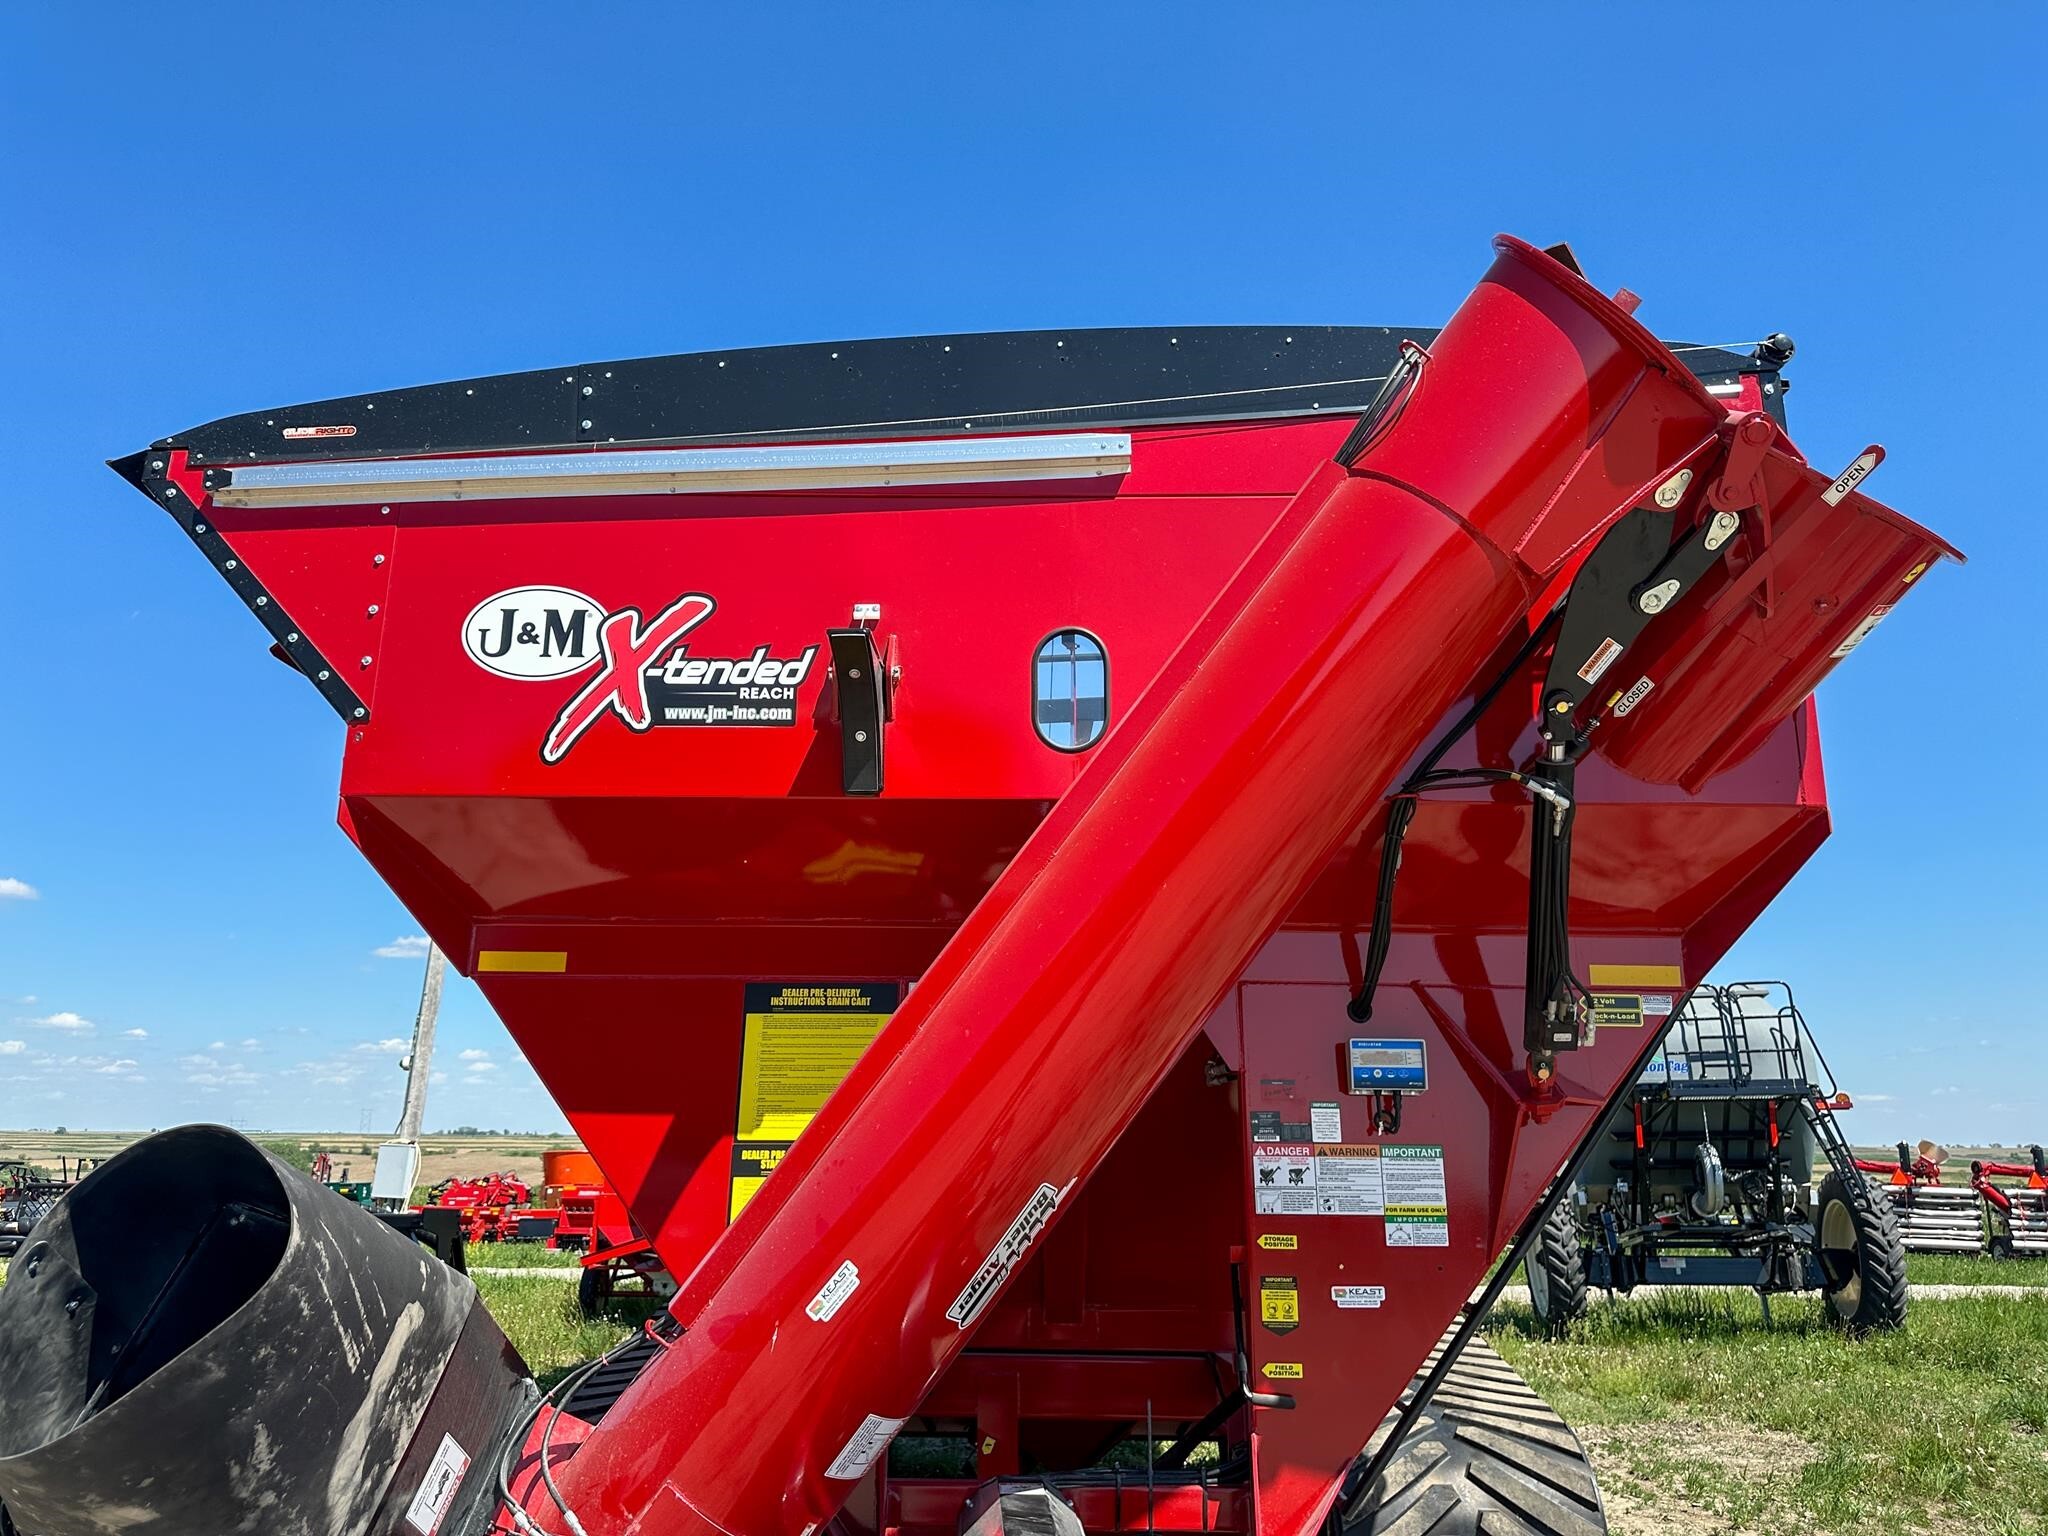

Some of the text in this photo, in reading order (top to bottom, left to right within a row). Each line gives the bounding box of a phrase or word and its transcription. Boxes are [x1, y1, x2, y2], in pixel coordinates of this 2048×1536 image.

[1834, 463, 1866, 495] OPEN
[479, 608, 589, 659] J&M
[1587, 642, 1611, 672] WARNING
[739, 687, 794, 700] REACH
[1617, 680, 1650, 713] CLOSED
[664, 705, 793, 724] www.jm-inc.com
[782, 988, 861, 997] DEALER PRE-DELIVERY
[770, 997, 872, 1006] INSTRUCTIONS GRAIN CART
[1644, 1060, 1688, 1074] onTag
[741, 1150, 770, 1160] DEALER
[1266, 1146, 1310, 1156] DANGER
[1328, 1147, 1378, 1157] WARNING
[1382, 1148, 1441, 1157] IMPORTANT
[957, 1189, 1050, 1316] Bullet Auger
[820, 1263, 851, 1300] KEAST
